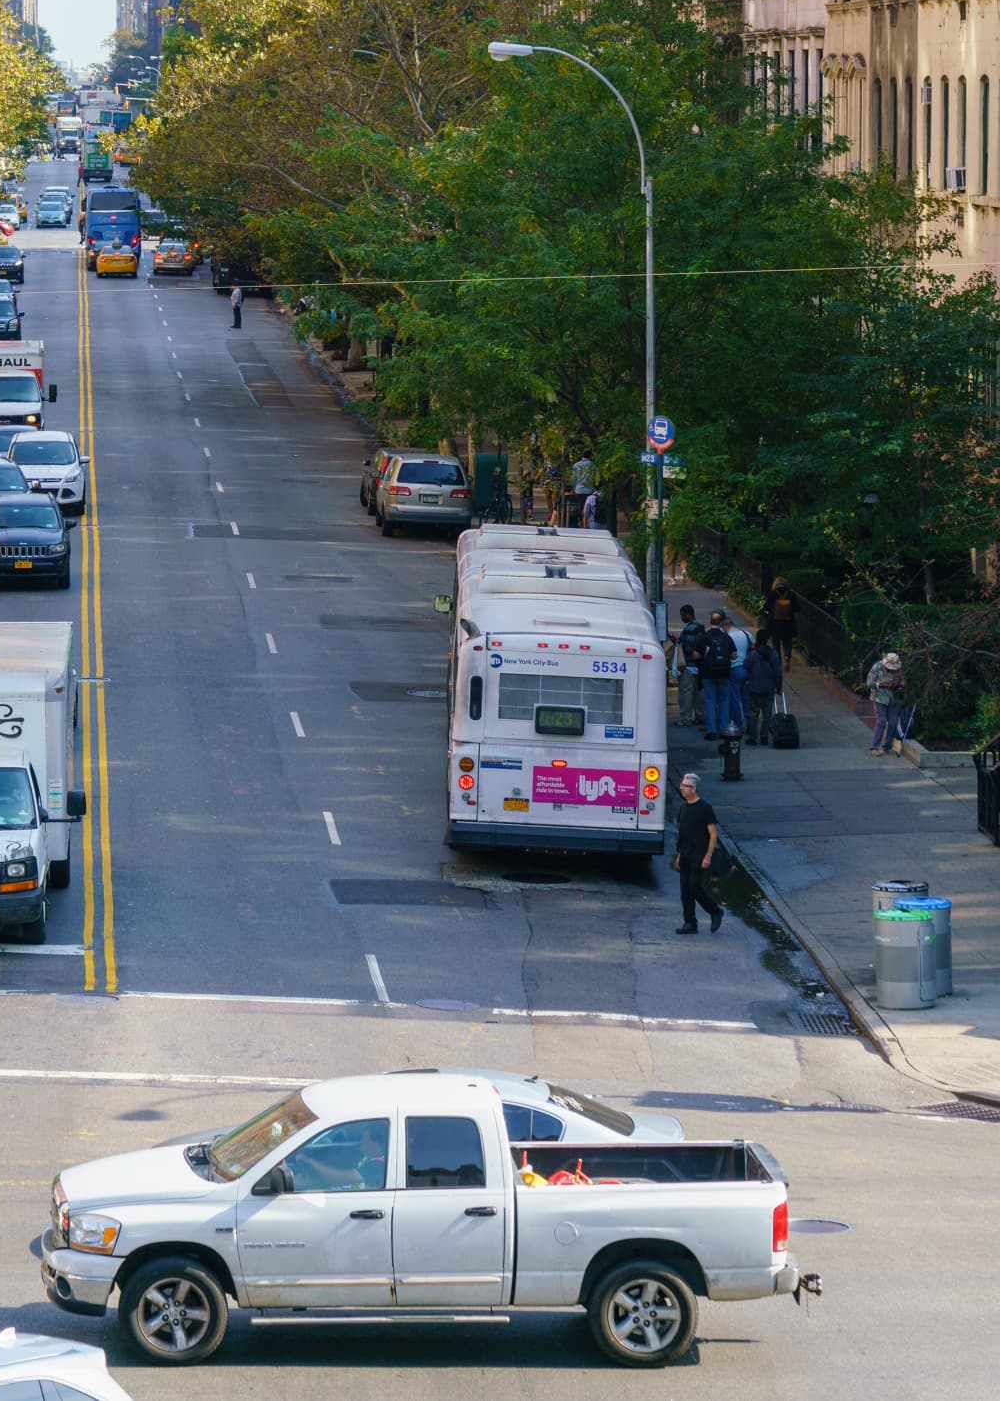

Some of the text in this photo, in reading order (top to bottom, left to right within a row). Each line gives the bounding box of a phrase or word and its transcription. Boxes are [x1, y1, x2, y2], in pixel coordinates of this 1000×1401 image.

[533, 659, 546, 667] City
[592, 661, 628, 674] 5534
[578, 774, 616, 802] lyft
